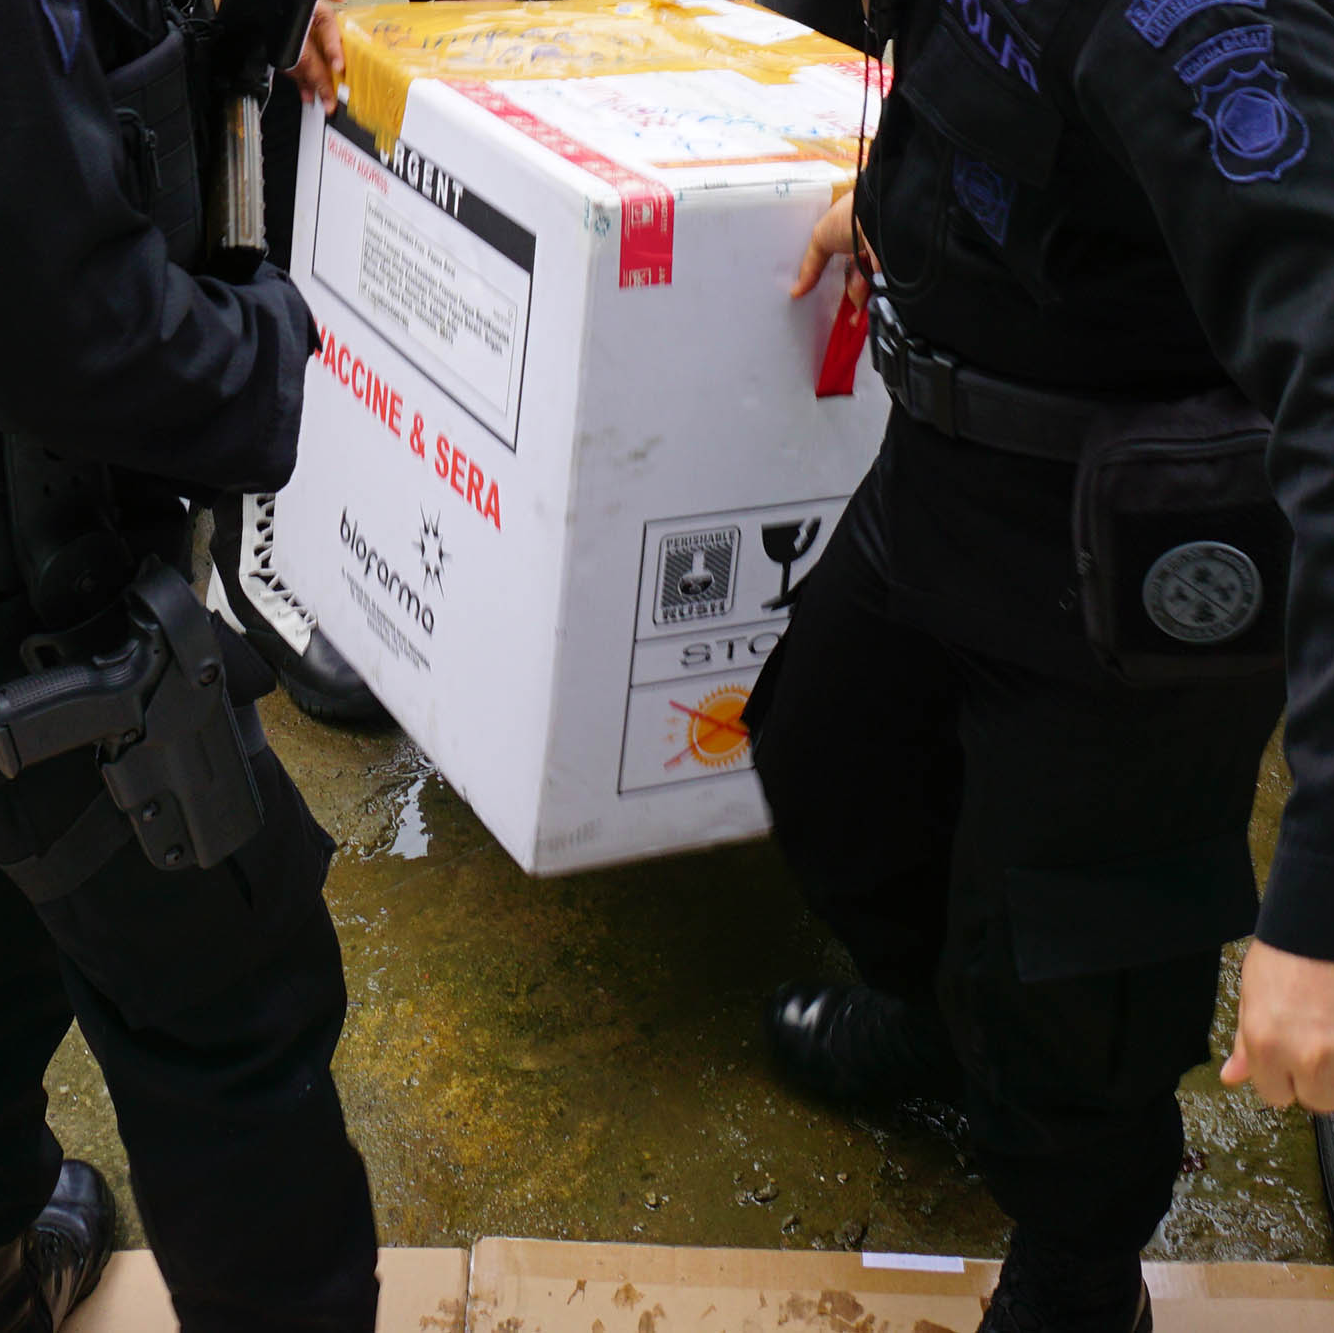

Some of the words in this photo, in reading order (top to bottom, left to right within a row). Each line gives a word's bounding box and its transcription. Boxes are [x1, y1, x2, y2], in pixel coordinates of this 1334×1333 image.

[408, 410, 426, 460] &
[434, 432, 502, 532] SERA
[666, 529, 737, 549] PERISHABLE
[339, 505, 436, 637] biofarma
[661, 600, 727, 622] RUSH
[681, 632, 784, 667] STO
